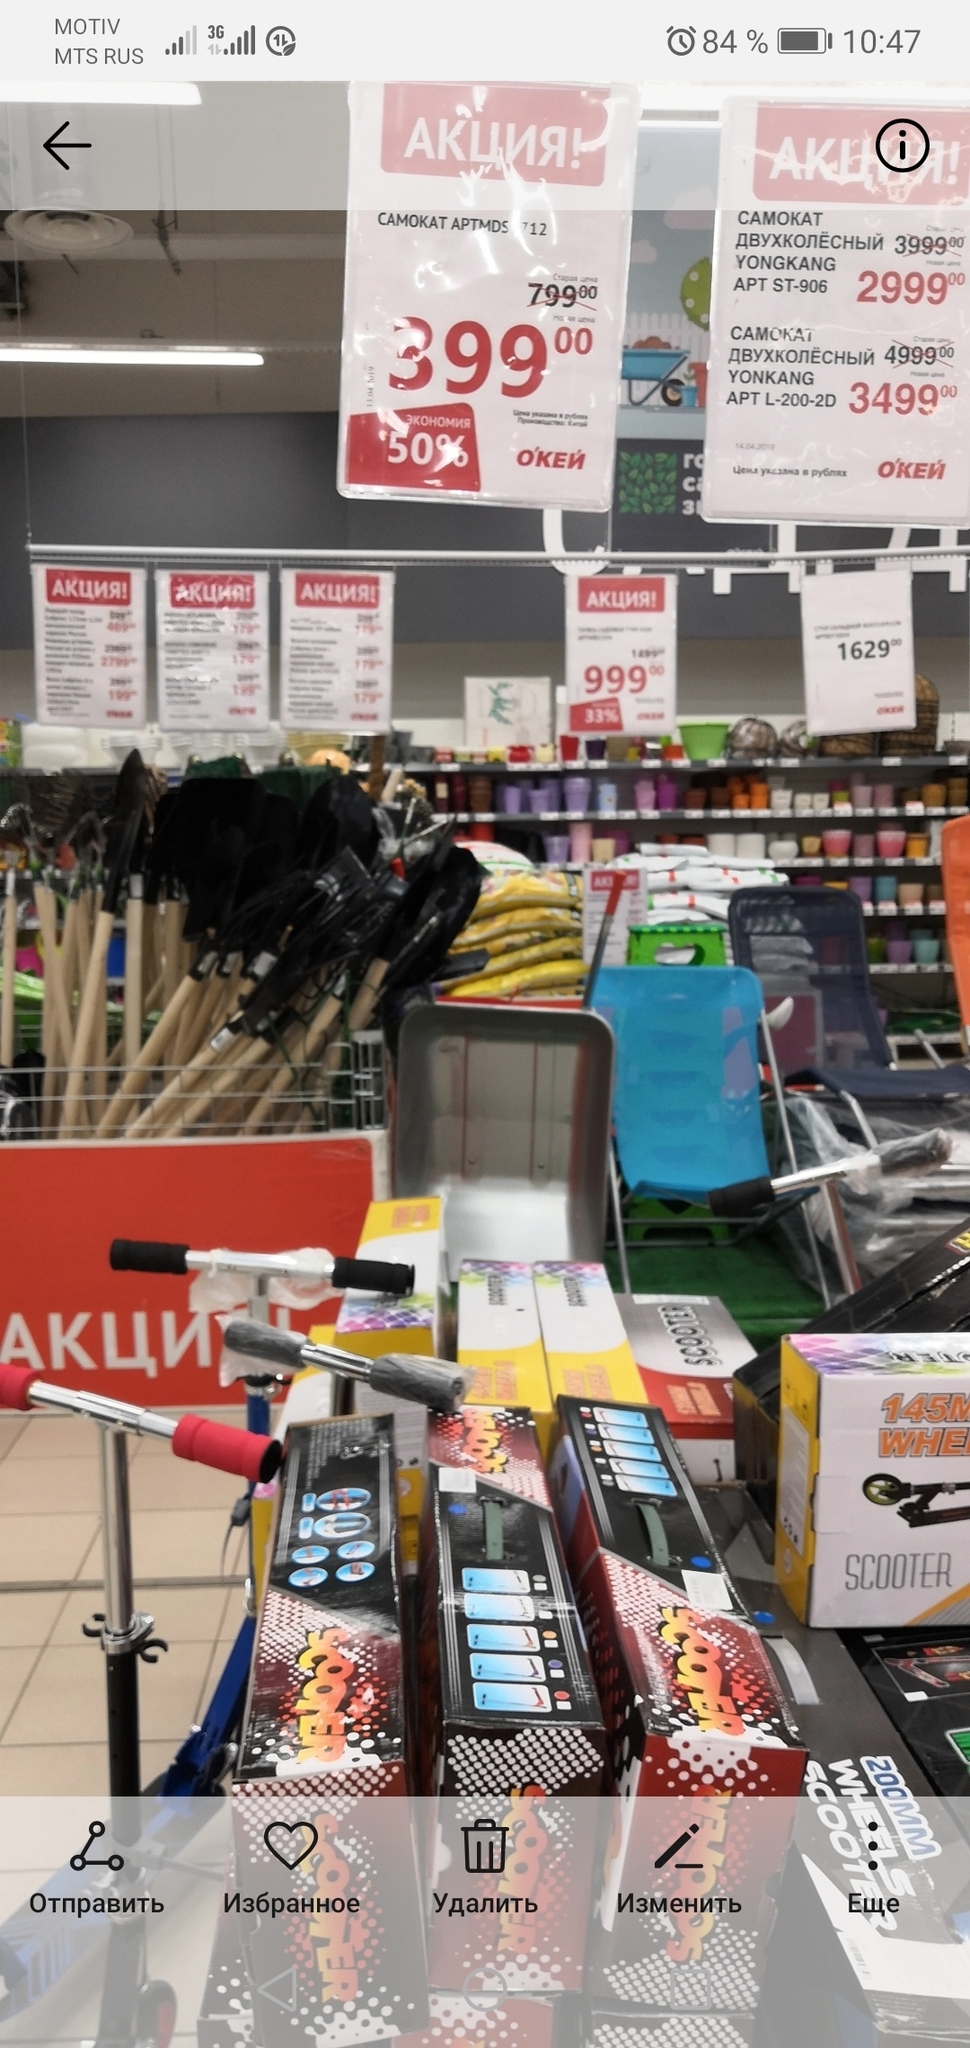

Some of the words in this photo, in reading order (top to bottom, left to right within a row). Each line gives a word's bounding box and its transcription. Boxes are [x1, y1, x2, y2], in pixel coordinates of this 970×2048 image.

[403, 116, 583, 171] АКЦИЯ!
[377, 211, 448, 230] САМОКАТ
[738, 210, 824, 226] САМОКАТ
[735, 230, 884, 251] ДВУХКОЛЁСНЫЙ
[735, 254, 837, 272] YONGKANG
[733, 277, 768, 292] АРТ
[772, 278, 828, 293] ST-906
[553, 314, 576, 323] Ноая
[730, 326, 815, 342] САМОКАТ
[728, 347, 875, 366] ДВУХКОЛЁСНЫЙ
[728, 370, 815, 386] YONKANG
[726, 391, 760, 405] АРТ
[765, 392, 837, 407] L-200-2D
[405, 413, 471, 429] ЭКОНОМИЯ
[387, 430, 469, 468] 50%
[52, 579, 127, 601] АКЦИЯ!
[175, 583, 251, 604] АКЦИЯ!
[301, 582, 376, 604] АКЦИЯ!
[586, 590, 656, 610] АКЦИЯ!
[584, 708, 619, 724] 33%
[657, 1304, 723, 1366] SCOOTER
[845, 1552, 953, 1591] SCOOTER
[659, 1607, 747, 1737] SCOOTER
[296, 1626, 355, 1765] SCOOTER
[861, 1756, 940, 1860] 200MM
[829, 1759, 916, 1898] WHEELS
